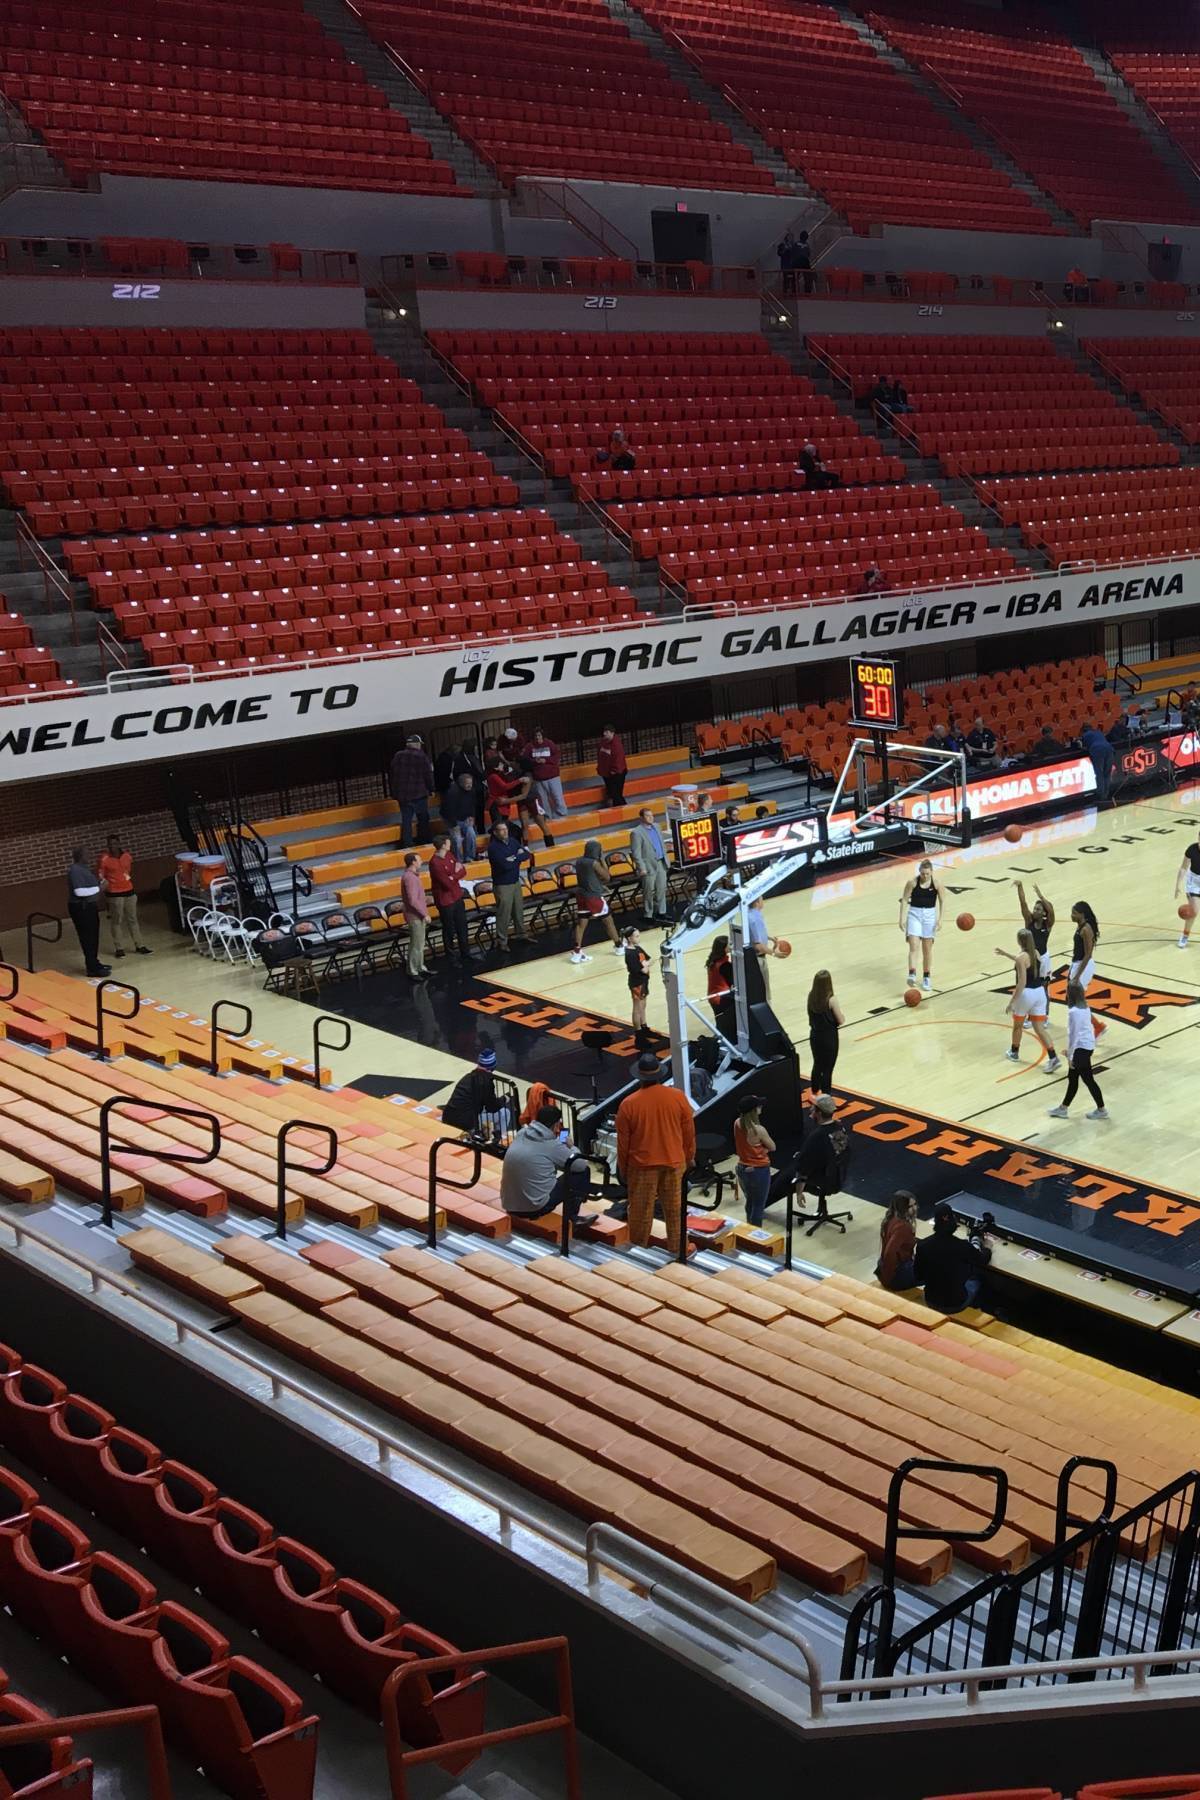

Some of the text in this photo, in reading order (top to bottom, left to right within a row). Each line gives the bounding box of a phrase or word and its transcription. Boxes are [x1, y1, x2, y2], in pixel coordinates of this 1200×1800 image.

[112, 284, 161, 298] 212
[584, 296, 617, 308] 213
[918, 305, 944, 316] 214
[0, 695, 272, 755] WELCOME
[290, 683, 359, 715] TO
[439, 635, 703, 697] HISTORIC
[1077, 573, 1184, 608] ARENA
[857, 665, 892, 685] 60:00
[864, 685, 890, 717] 30
[1122, 746, 1158, 775] OSU
[680, 819, 712, 839] 60:00
[687, 836, 709, 858] 30
